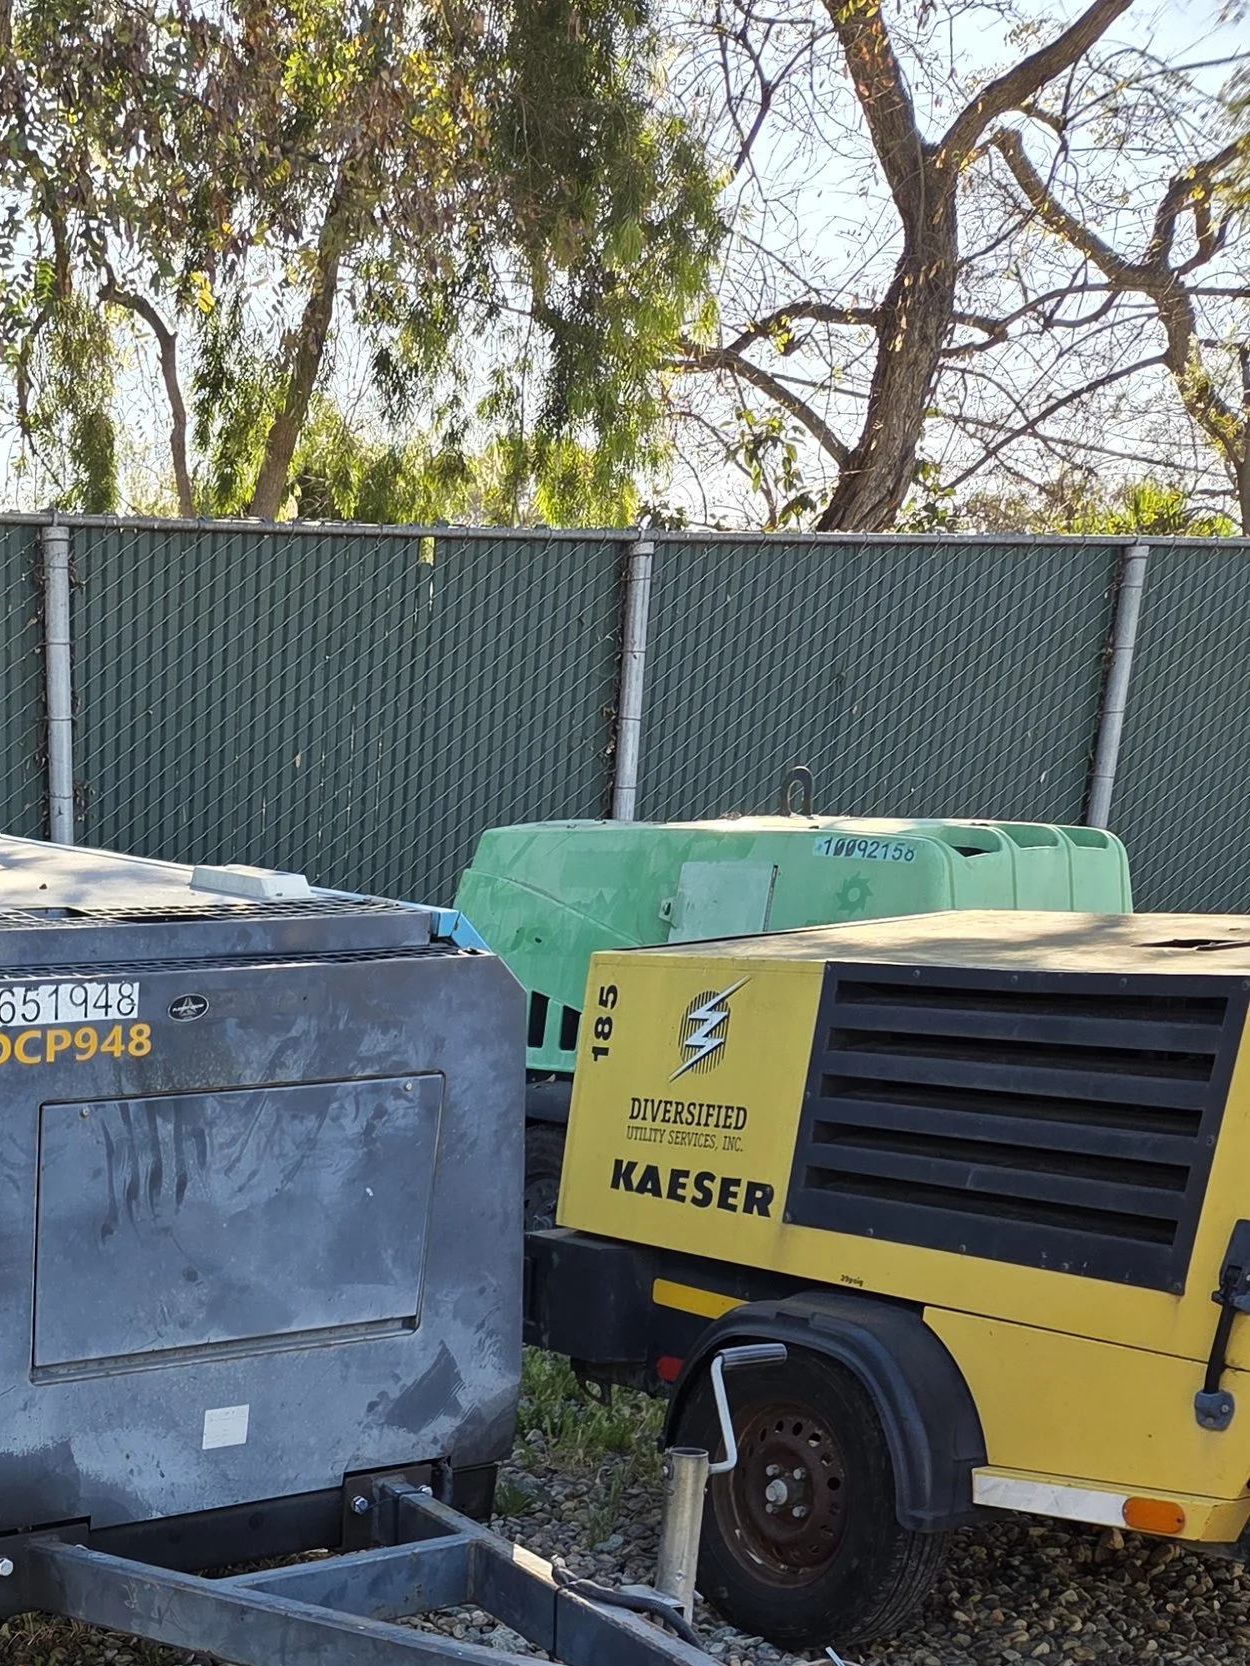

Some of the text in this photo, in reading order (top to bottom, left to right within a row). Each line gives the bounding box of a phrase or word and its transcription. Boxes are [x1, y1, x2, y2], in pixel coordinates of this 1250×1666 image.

[591, 984, 618, 1062] 185
[628, 1096, 748, 1131] DIVERSIFIED
[626, 1125, 744, 1153] UTILITY SERVICES, INC.
[610, 1158, 775, 1218] KAESER
